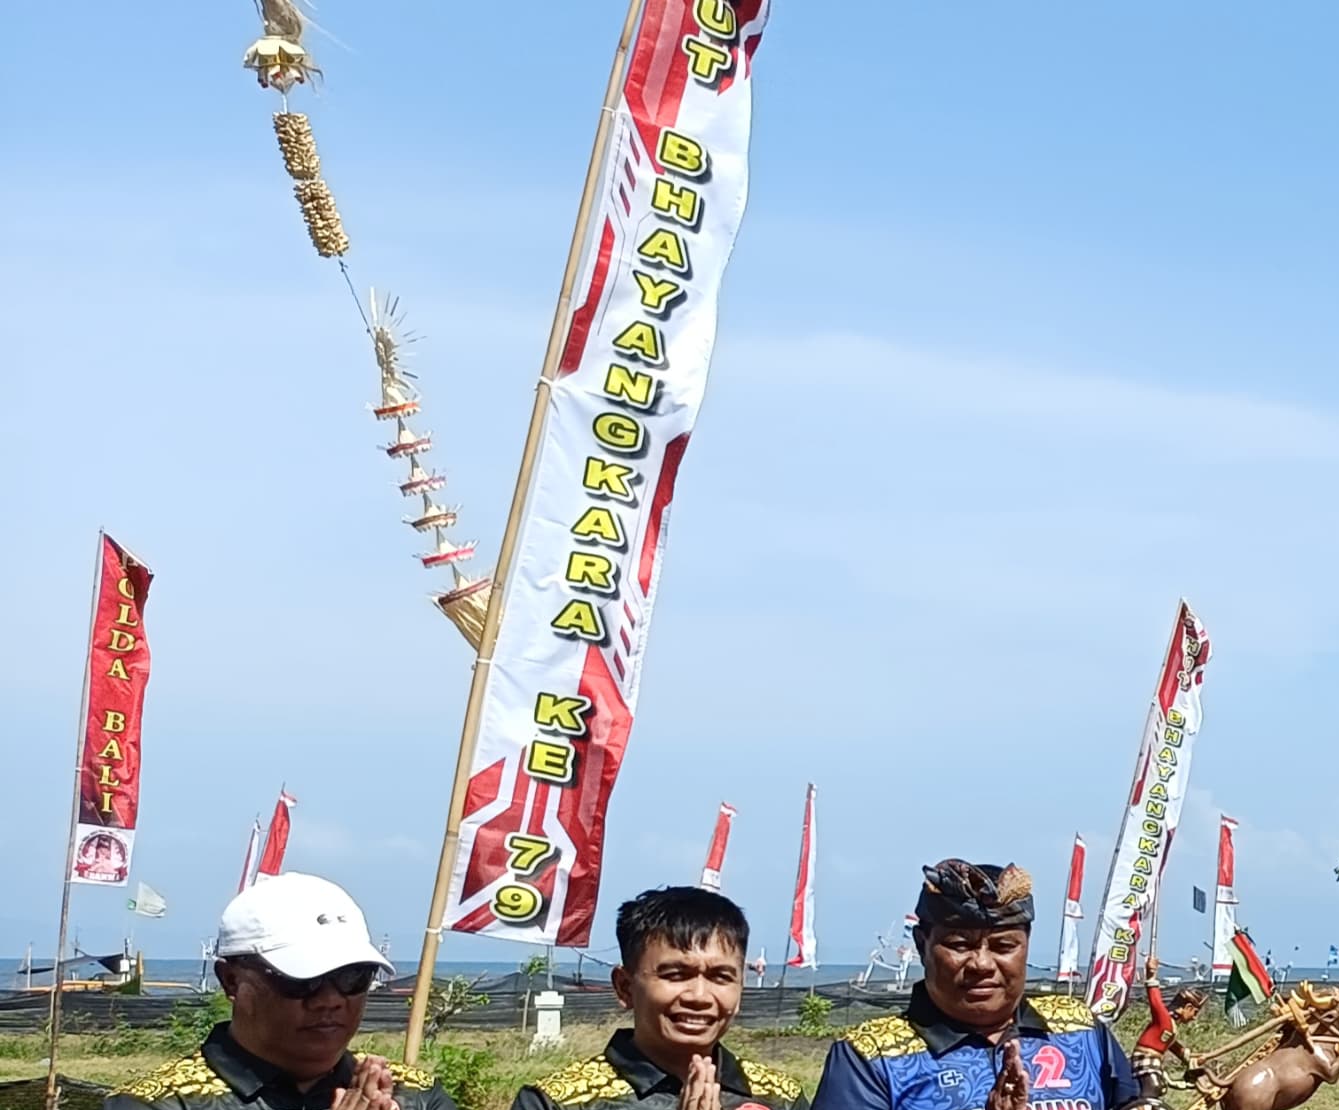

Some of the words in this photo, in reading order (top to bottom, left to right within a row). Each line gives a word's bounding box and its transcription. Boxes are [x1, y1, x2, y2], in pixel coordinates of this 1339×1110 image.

[553, 131, 703, 642] BHAYANGKARA
[98, 711, 125, 812] BALI
[528, 694, 588, 780] KE
[1123, 709, 1185, 909] BHAYANGKARA
[492, 837, 553, 920] 79
[1110, 927, 1135, 962] KE
